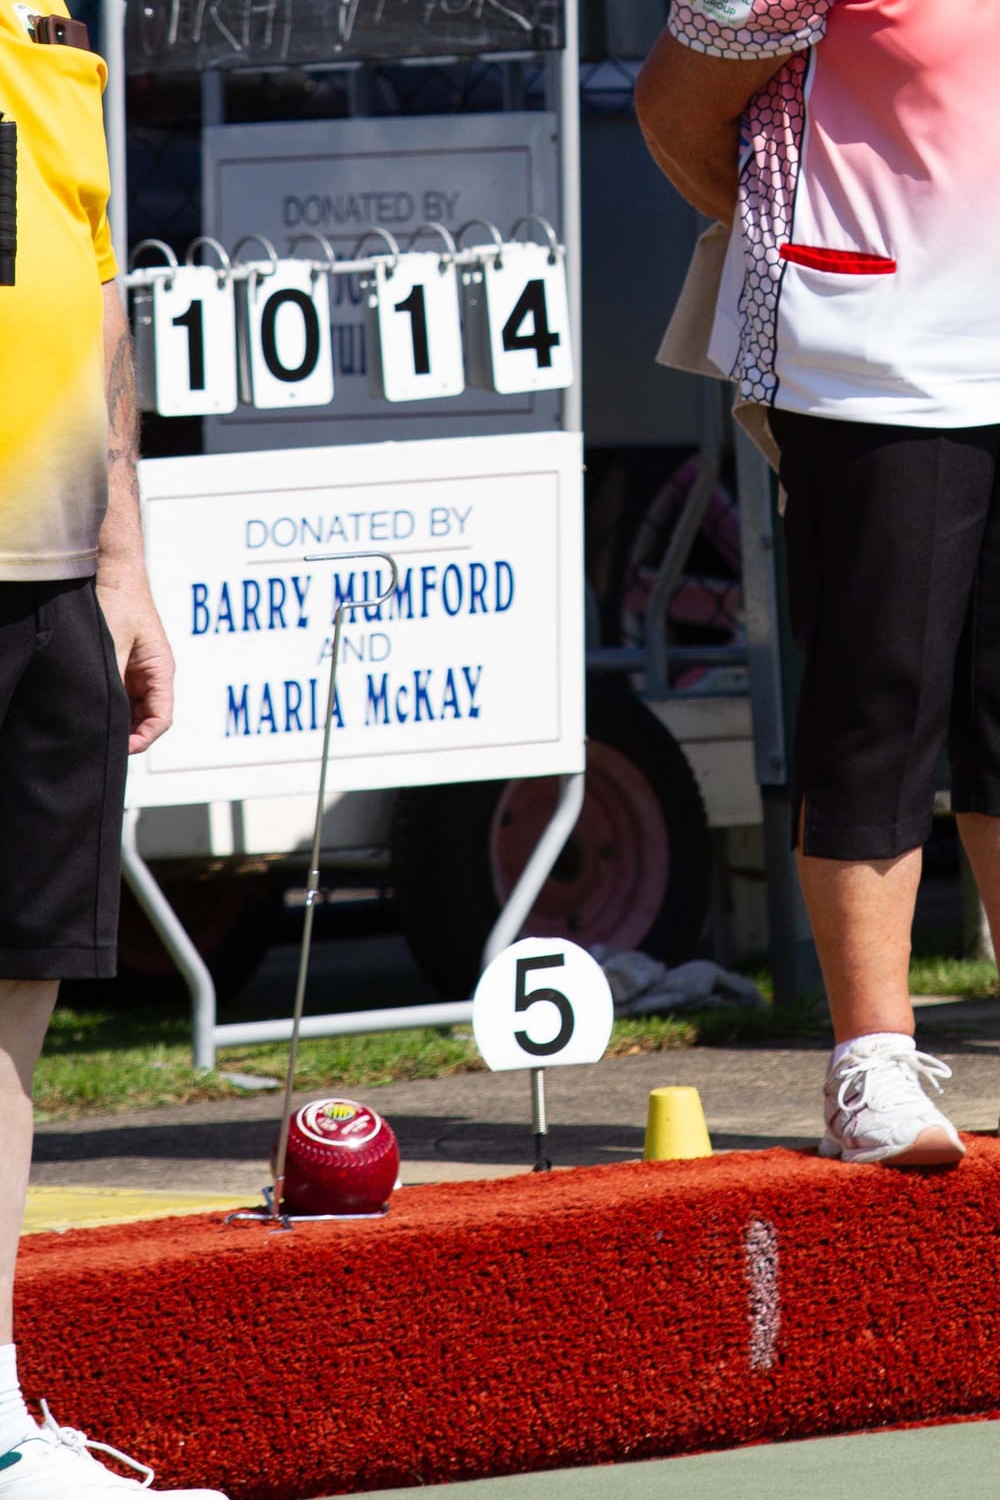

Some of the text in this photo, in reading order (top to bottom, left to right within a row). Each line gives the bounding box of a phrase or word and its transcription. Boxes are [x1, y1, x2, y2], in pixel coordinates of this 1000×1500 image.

[282, 189, 461, 227] DONATED BY
[245, 505, 473, 549] DONATED BY
[190, 560, 515, 635] BARRY MUMFORD
[316, 633, 392, 665] AND
[225, 665, 483, 738] MARIA McKAY
[513, 953, 575, 1056] 5
